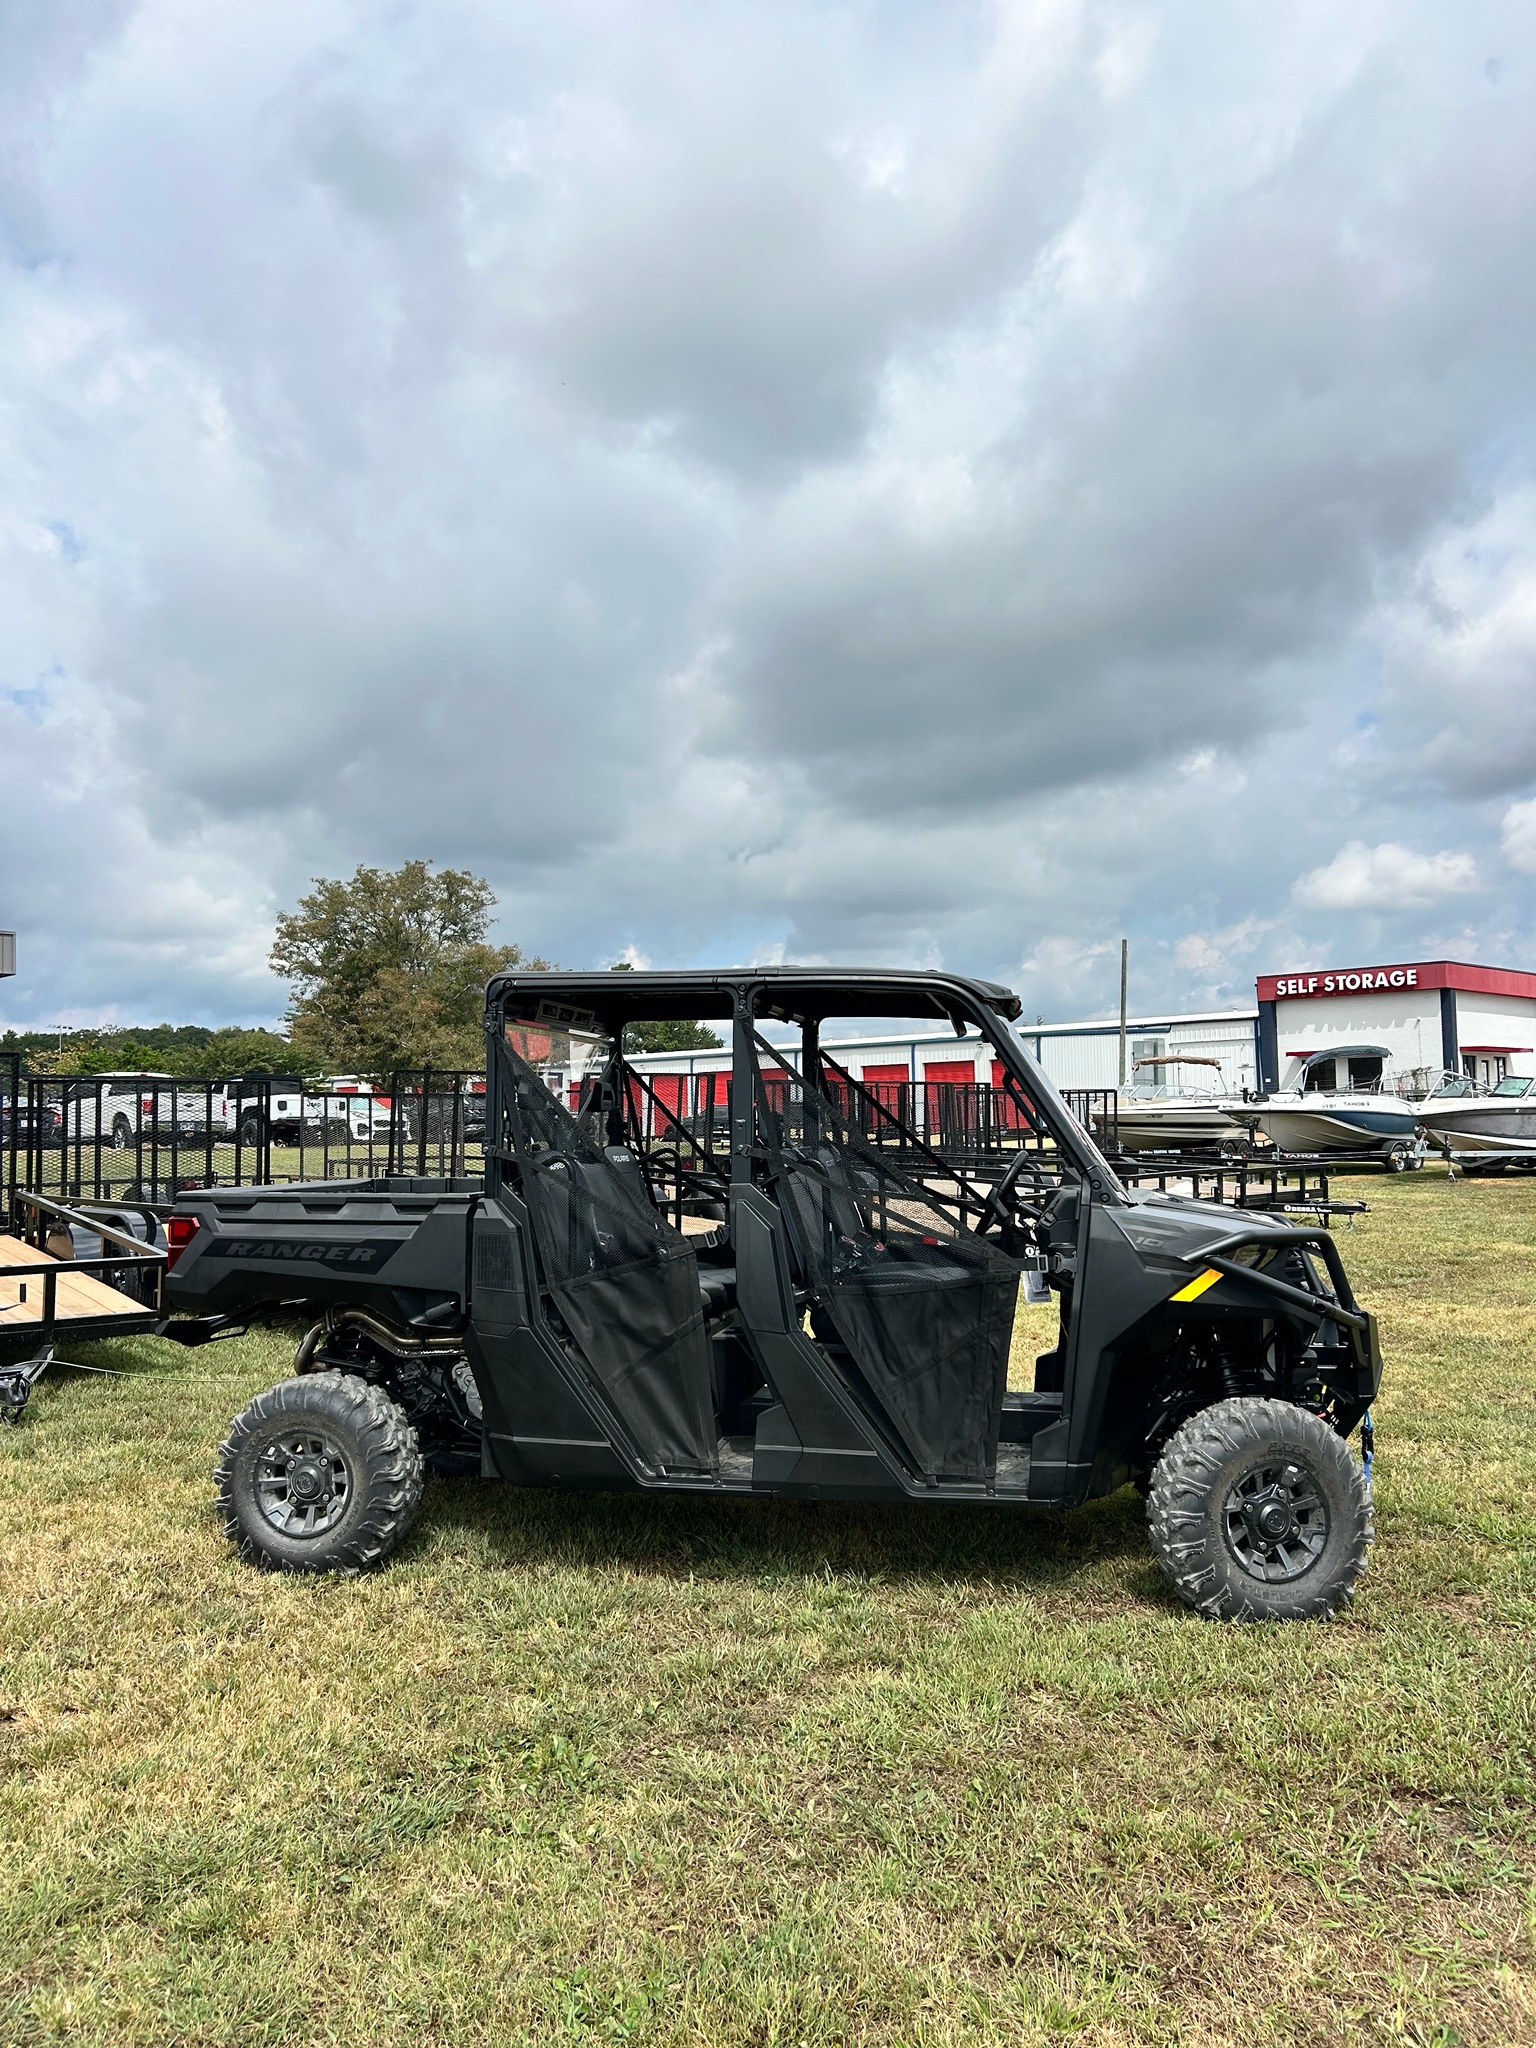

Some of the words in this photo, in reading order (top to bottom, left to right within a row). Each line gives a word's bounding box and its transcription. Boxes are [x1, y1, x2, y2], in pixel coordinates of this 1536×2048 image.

[1276, 978, 1318, 996] SELF
[1324, 969, 1418, 992] STORAGE
[612, 1155, 630, 1163] POLARIS
[225, 1241, 377, 1262] RANGER
